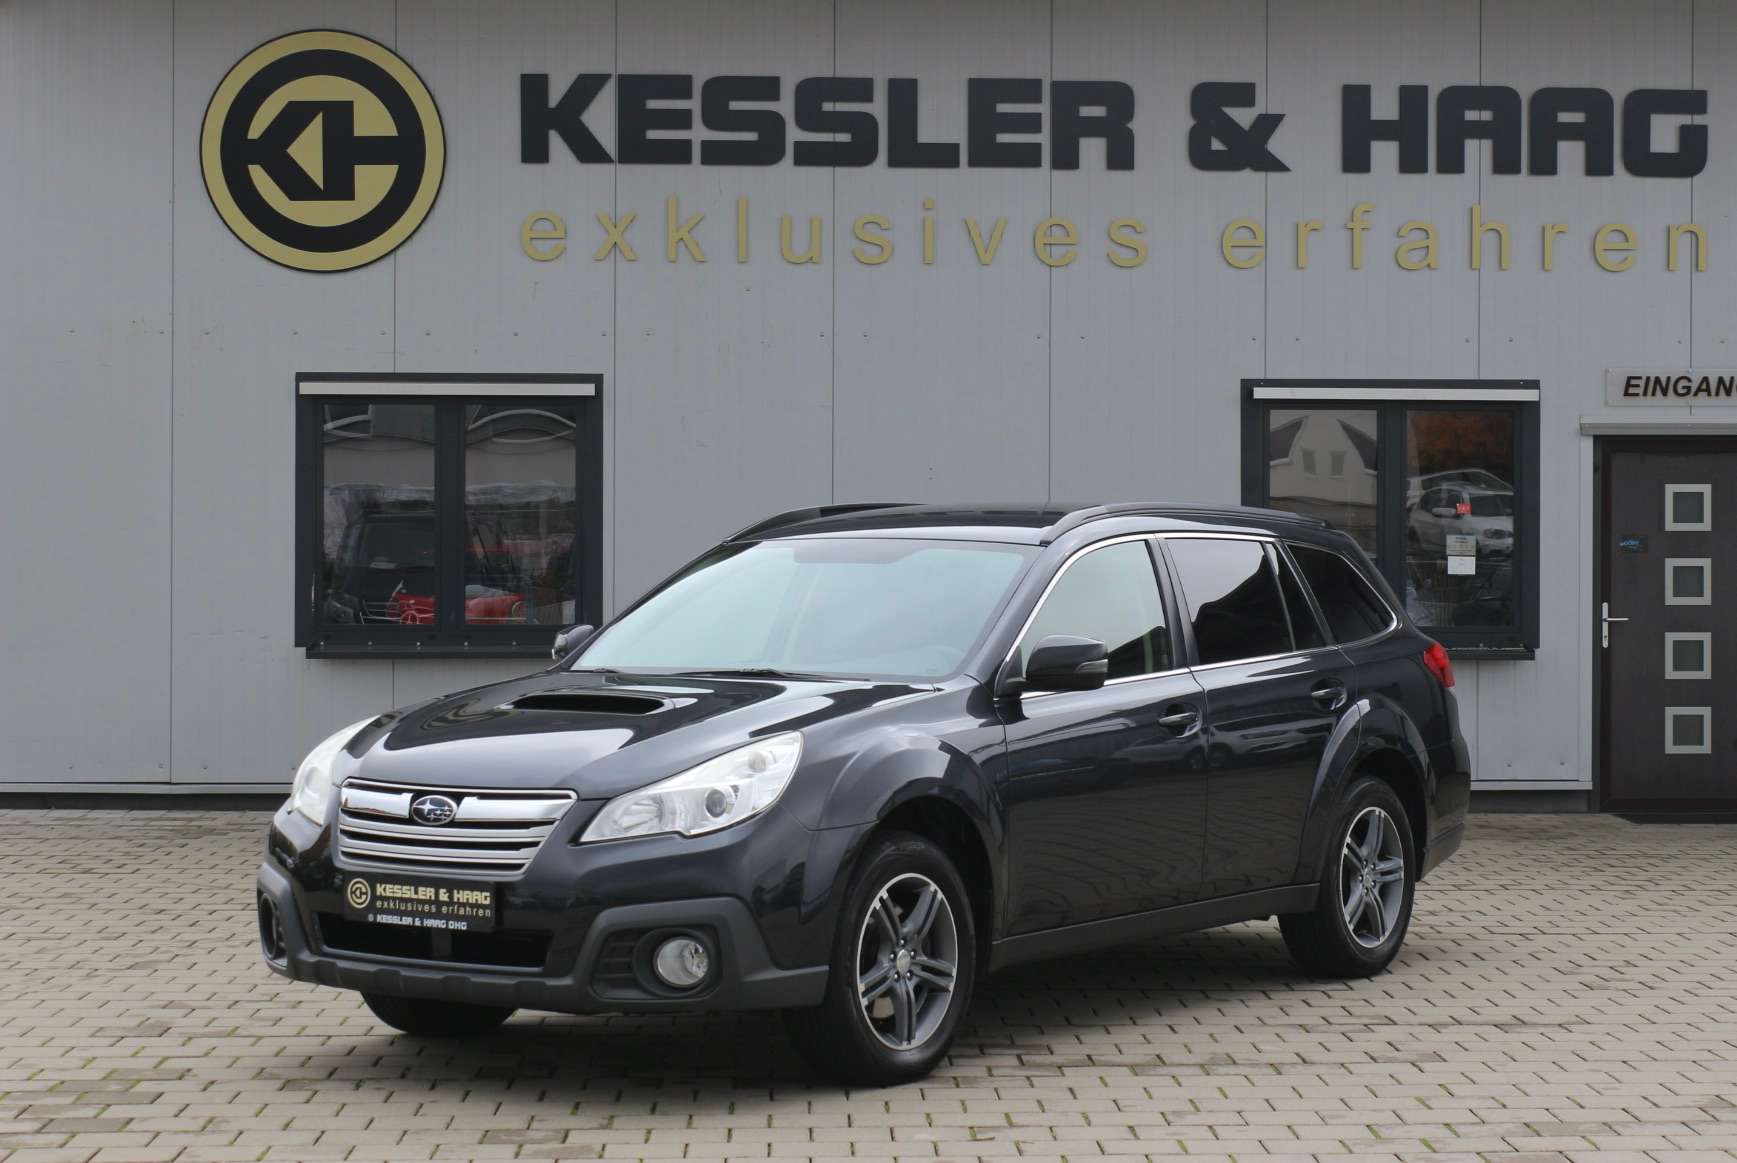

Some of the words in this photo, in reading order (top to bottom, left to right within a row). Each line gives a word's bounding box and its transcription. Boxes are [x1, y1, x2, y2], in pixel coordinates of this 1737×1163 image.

[519, 73, 1135, 170] KESSLER
[1188, 82, 1292, 173] &
[1341, 84, 1708, 178] HAAG
[519, 197, 1148, 268] exklusives
[1221, 203, 1709, 273] erfahren
[1623, 375, 1737, 398] EINGAN
[376, 883, 435, 900] KESSLER
[438, 888, 450, 901] &
[453, 889, 491, 905] HAAG
[375, 900, 436, 913] exklusives
[441, 905, 491, 918] erfahren
[376, 914, 413, 925] KESSLER
[414, 917, 421, 926] &
[423, 918, 447, 929] HAAG
